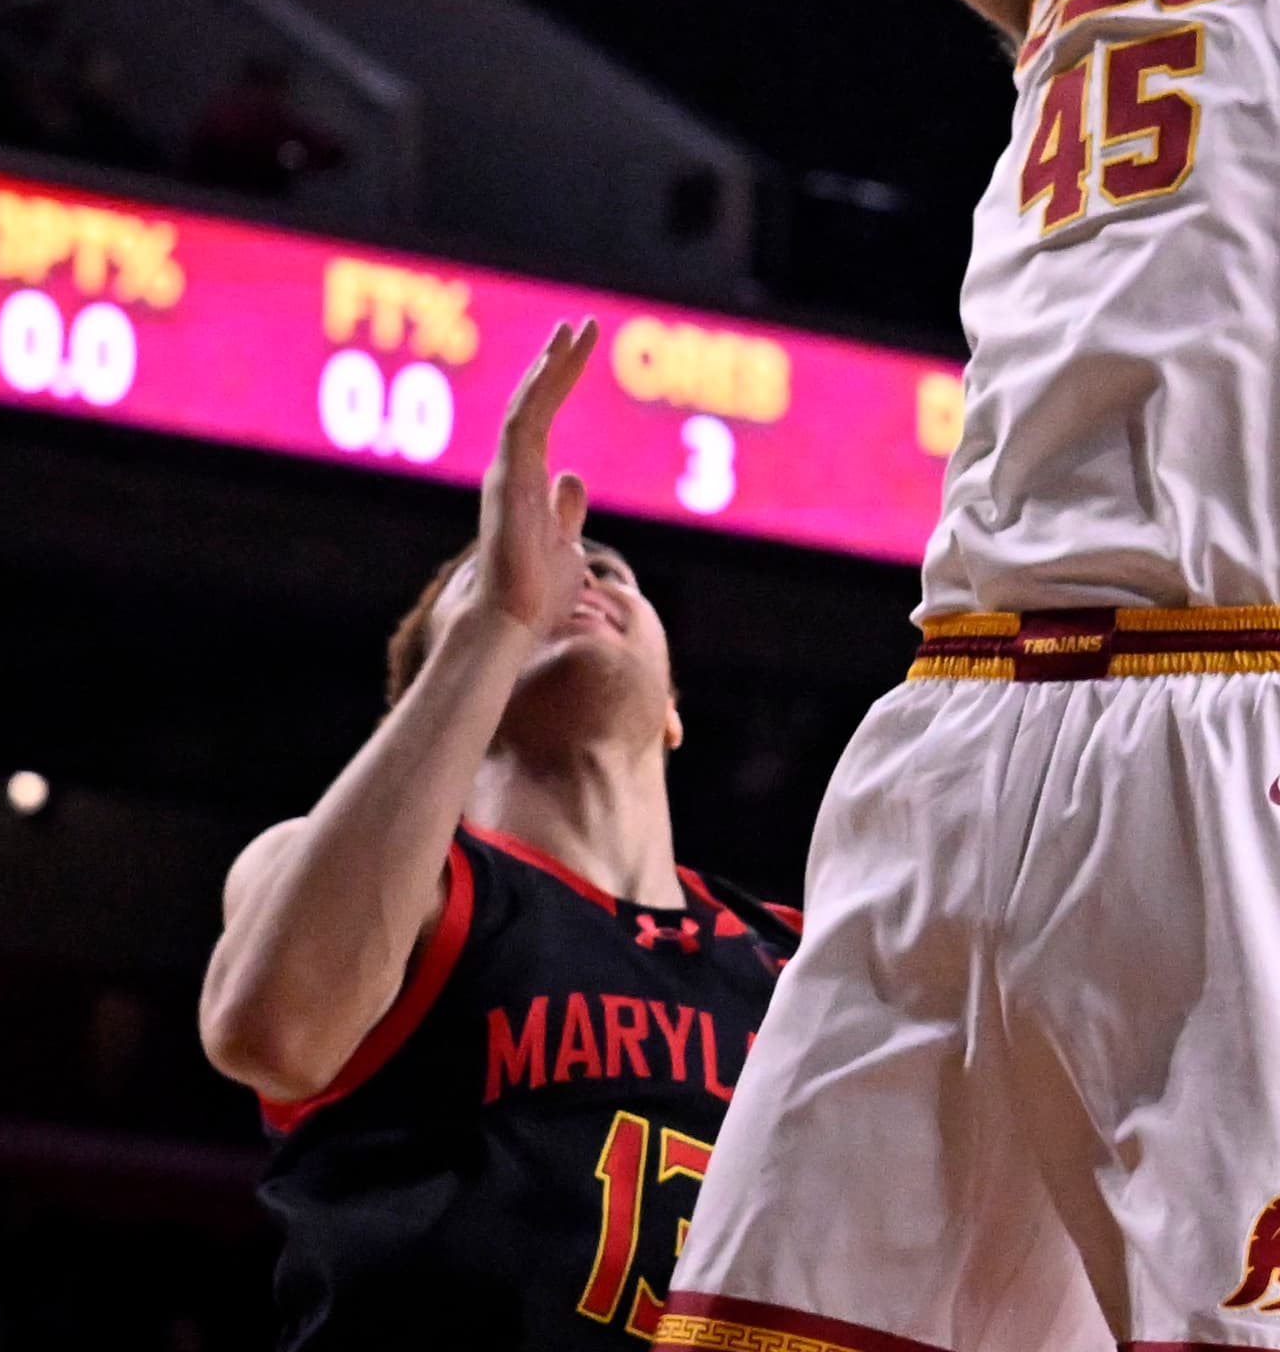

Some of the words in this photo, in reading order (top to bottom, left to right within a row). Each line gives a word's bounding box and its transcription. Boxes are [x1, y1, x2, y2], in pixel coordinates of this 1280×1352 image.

[1019, 21, 1205, 236] 45
[322, 257, 479, 365] FT%
[319, 349, 454, 463] 0.0
[676, 414, 737, 514] 3
[1023, 635, 1103, 655] TROJANS
[483, 992, 758, 1104] MARYL
